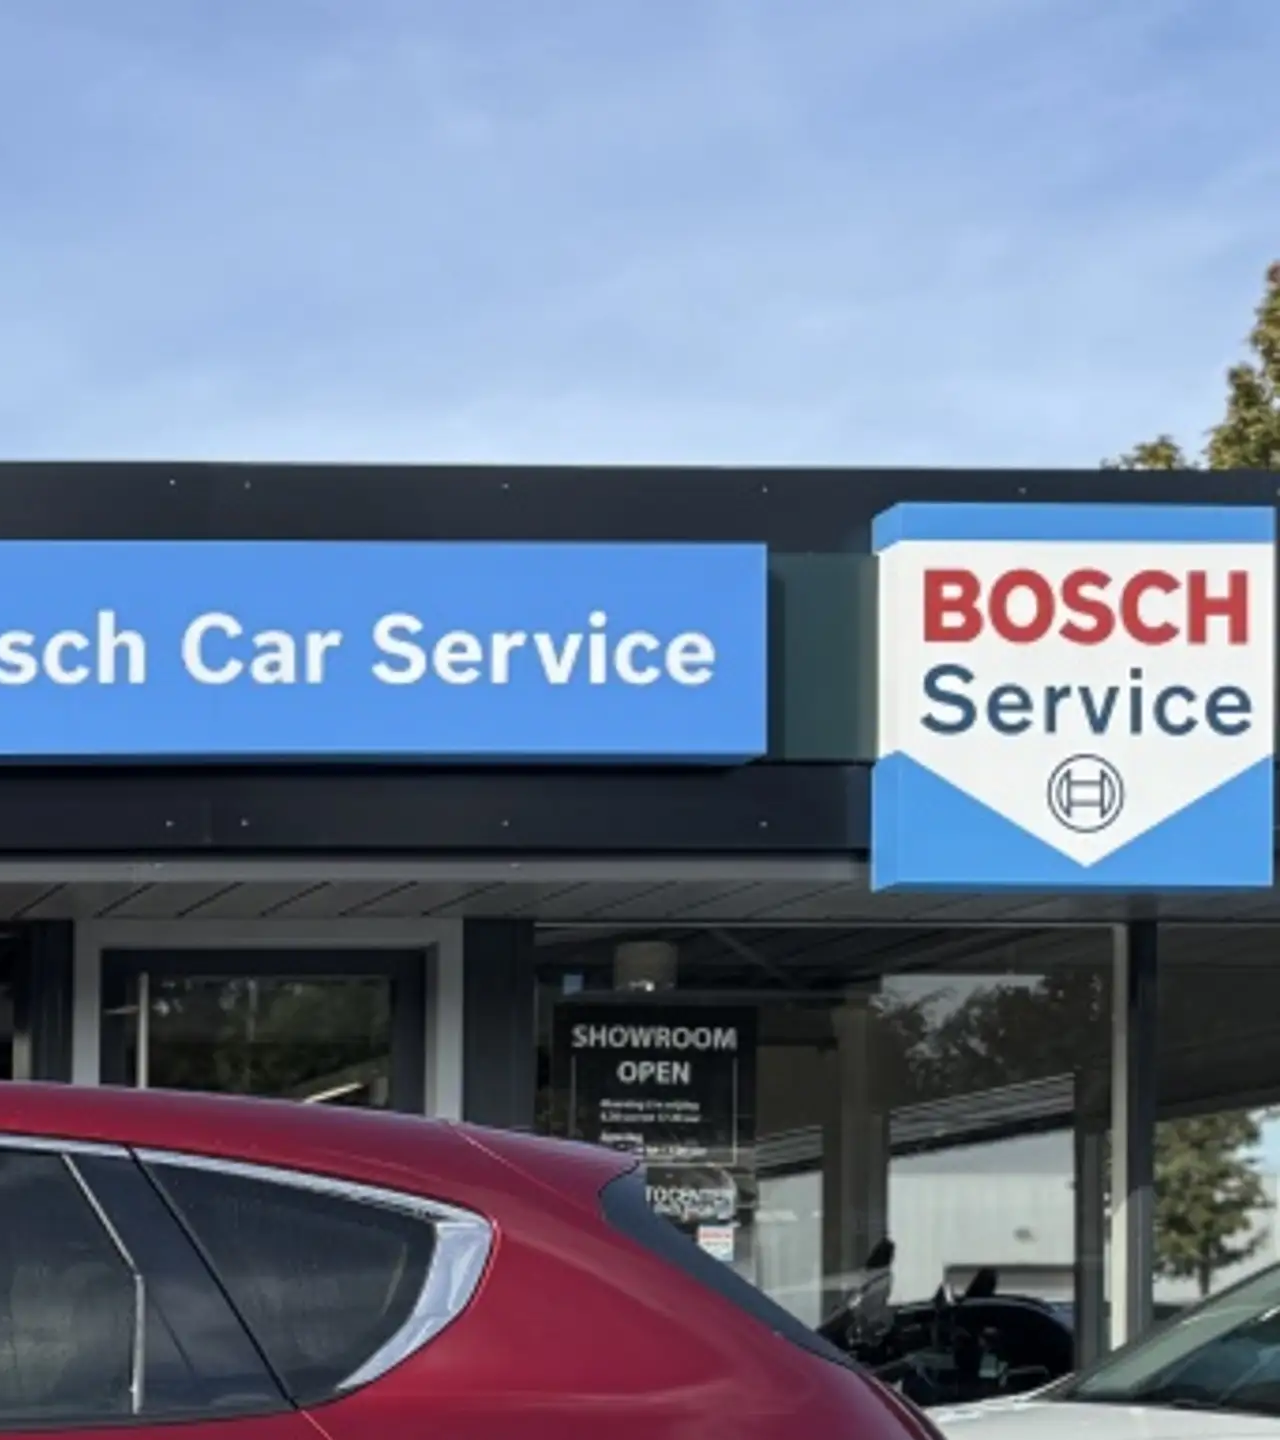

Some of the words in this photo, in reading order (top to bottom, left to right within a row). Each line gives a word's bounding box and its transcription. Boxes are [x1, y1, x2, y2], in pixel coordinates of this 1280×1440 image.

[923, 568, 1249, 646] BOSCH
[180, 611, 343, 687] Car
[370, 611, 717, 687] Service
[920, 663, 1253, 737] Service
[571, 1024, 738, 1050] SHOWROOM
[616, 1060, 691, 1085] OPEN
